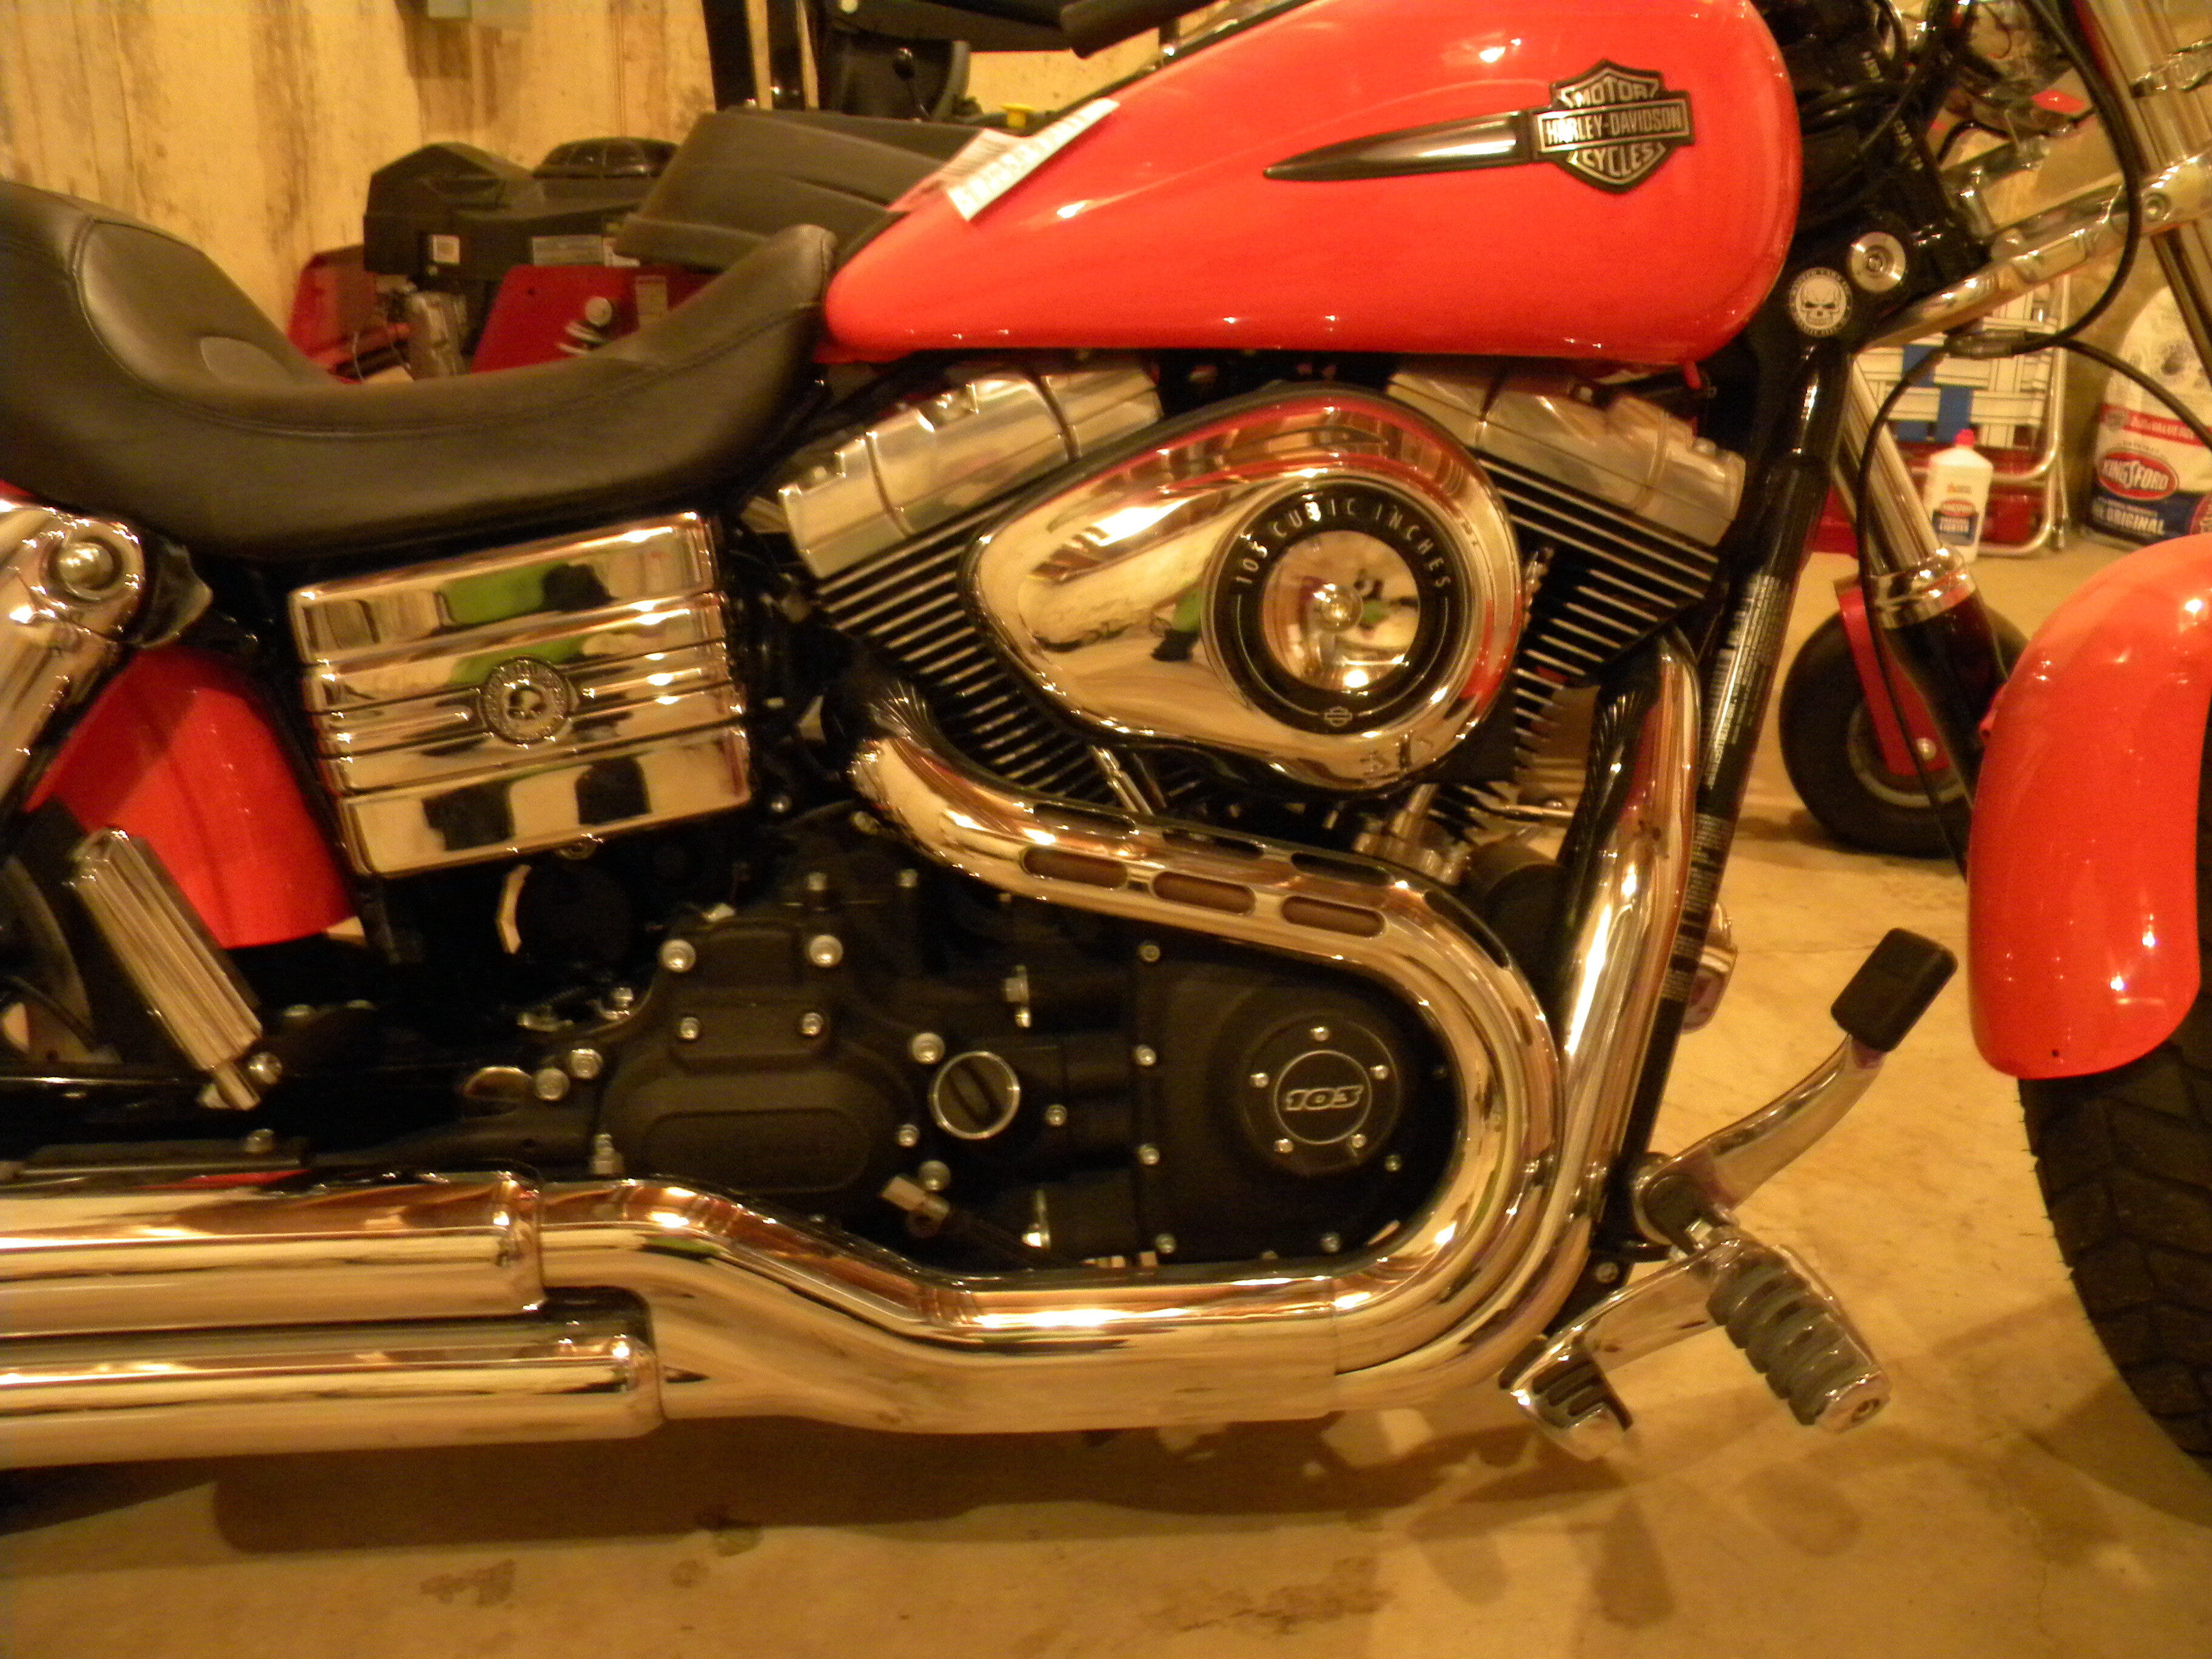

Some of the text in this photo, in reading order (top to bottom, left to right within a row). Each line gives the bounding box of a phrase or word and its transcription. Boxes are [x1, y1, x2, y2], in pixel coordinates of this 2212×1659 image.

[1573, 76, 1649, 107] MOTOR
[1546, 105, 1683, 145] HARLEY-DAVIDSON
[1582, 141, 1654, 177] CYCLES
[2102, 458, 2170, 491] KINGSFORD
[2106, 507, 2165, 536] ORIGINAL
[1273, 498, 1356, 538] CUBIC
[1376, 504, 1451, 589] INCHES
